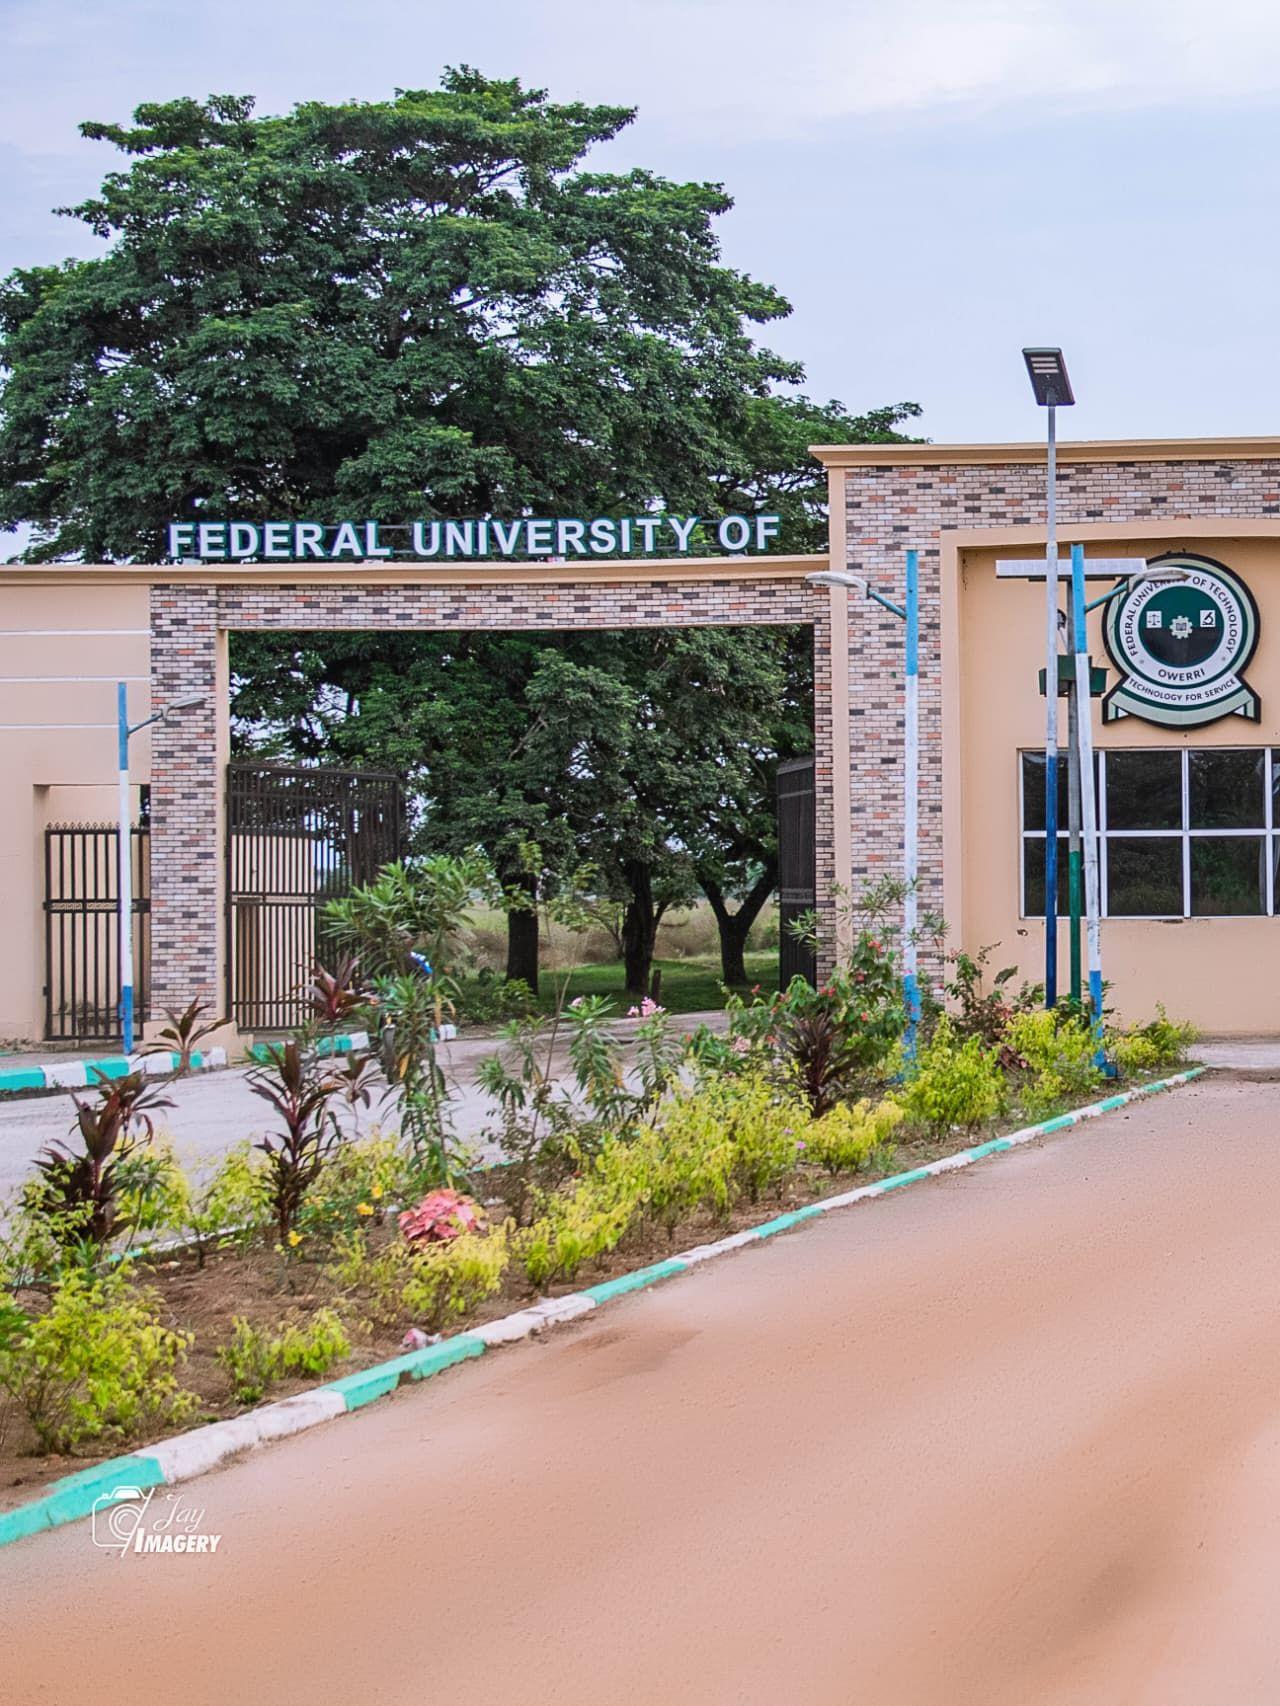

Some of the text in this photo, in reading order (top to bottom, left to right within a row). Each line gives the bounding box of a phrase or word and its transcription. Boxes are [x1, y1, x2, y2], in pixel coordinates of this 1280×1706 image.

[168, 514, 780, 558] FEDERAL UNIVERSITY OF
[1125, 609, 1138, 657] FEDERAL
[1192, 576, 1207, 587] OF
[1209, 582, 1238, 654] TECHNOLOGY
[1129, 677, 1236, 701] TECHNOLOGY FOR SERVICE
[1158, 668, 1205, 682] OWERRI
